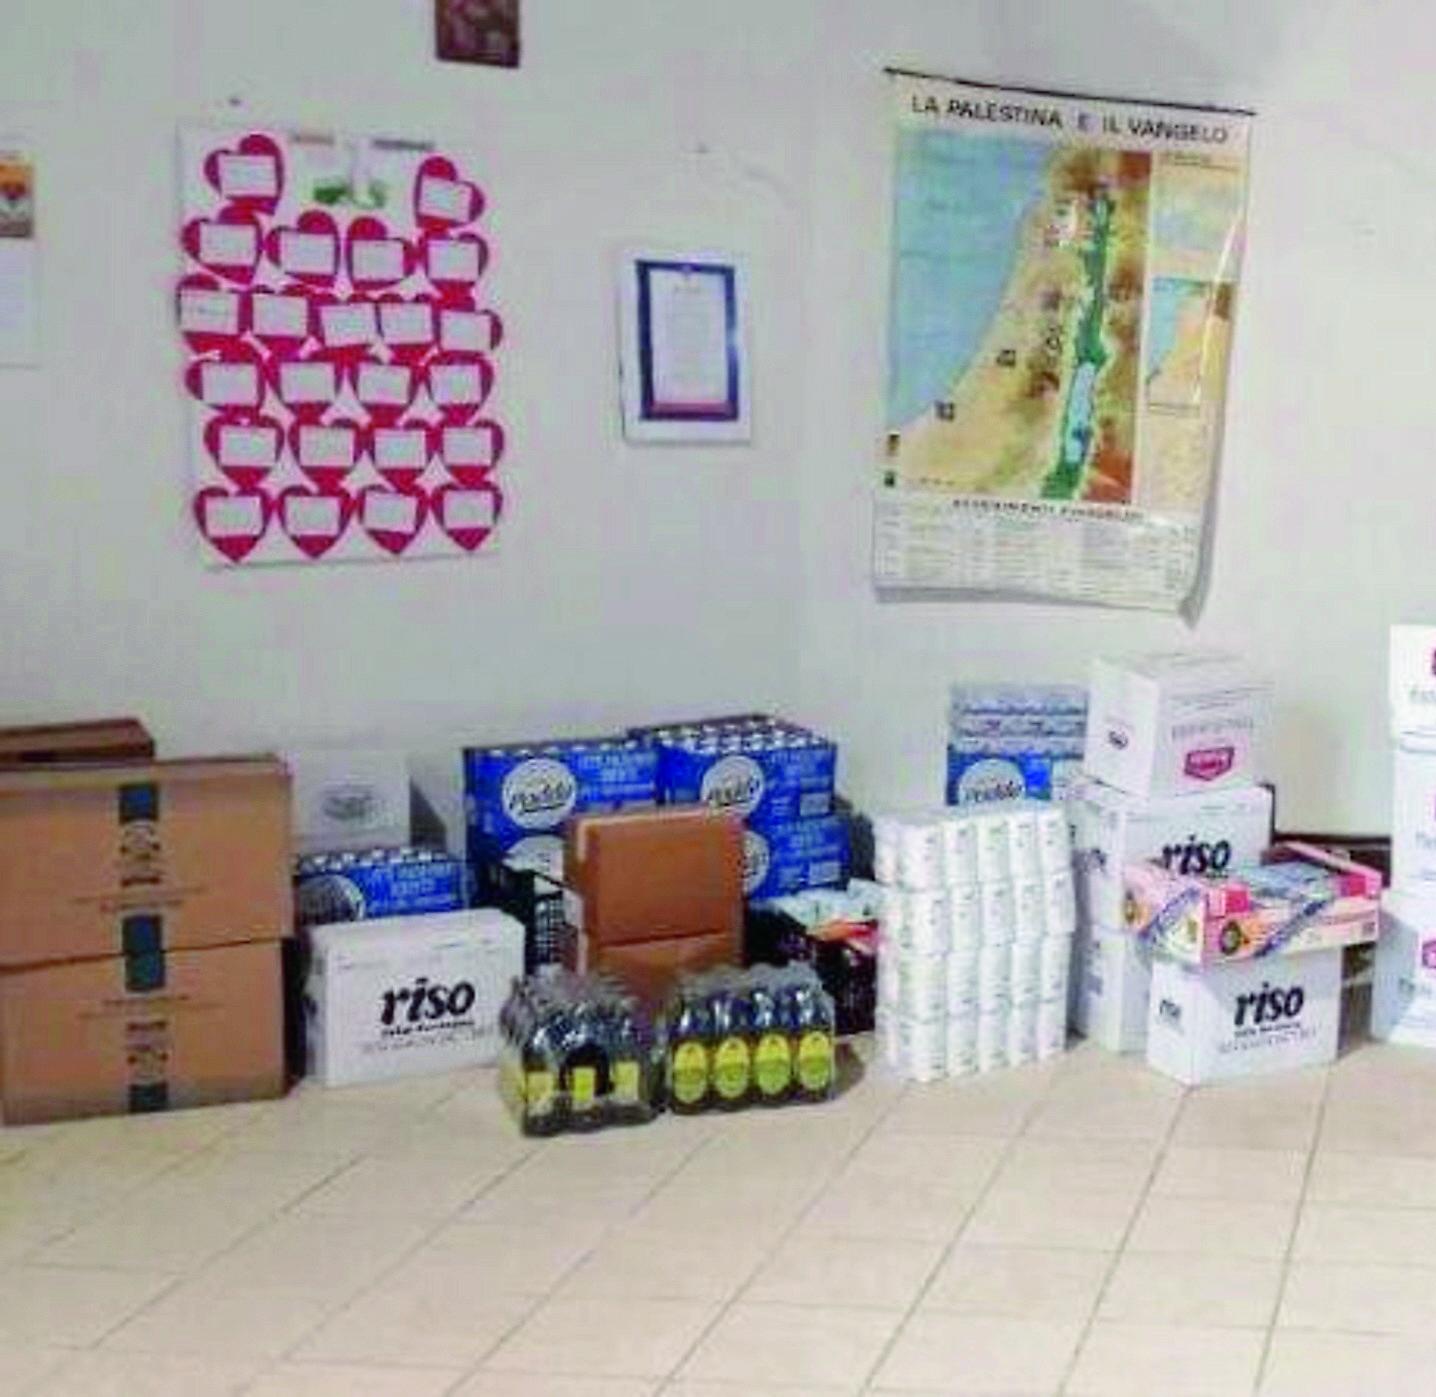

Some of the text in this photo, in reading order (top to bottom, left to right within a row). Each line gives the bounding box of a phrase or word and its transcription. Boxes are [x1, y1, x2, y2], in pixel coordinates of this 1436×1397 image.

[911, 95, 940, 116] LA
[945, 97, 1063, 130] PALESTINA
[1126, 117, 1229, 144] VANGELO
[380, 977, 476, 1026] riso
[1232, 982, 1305, 1028] riso
